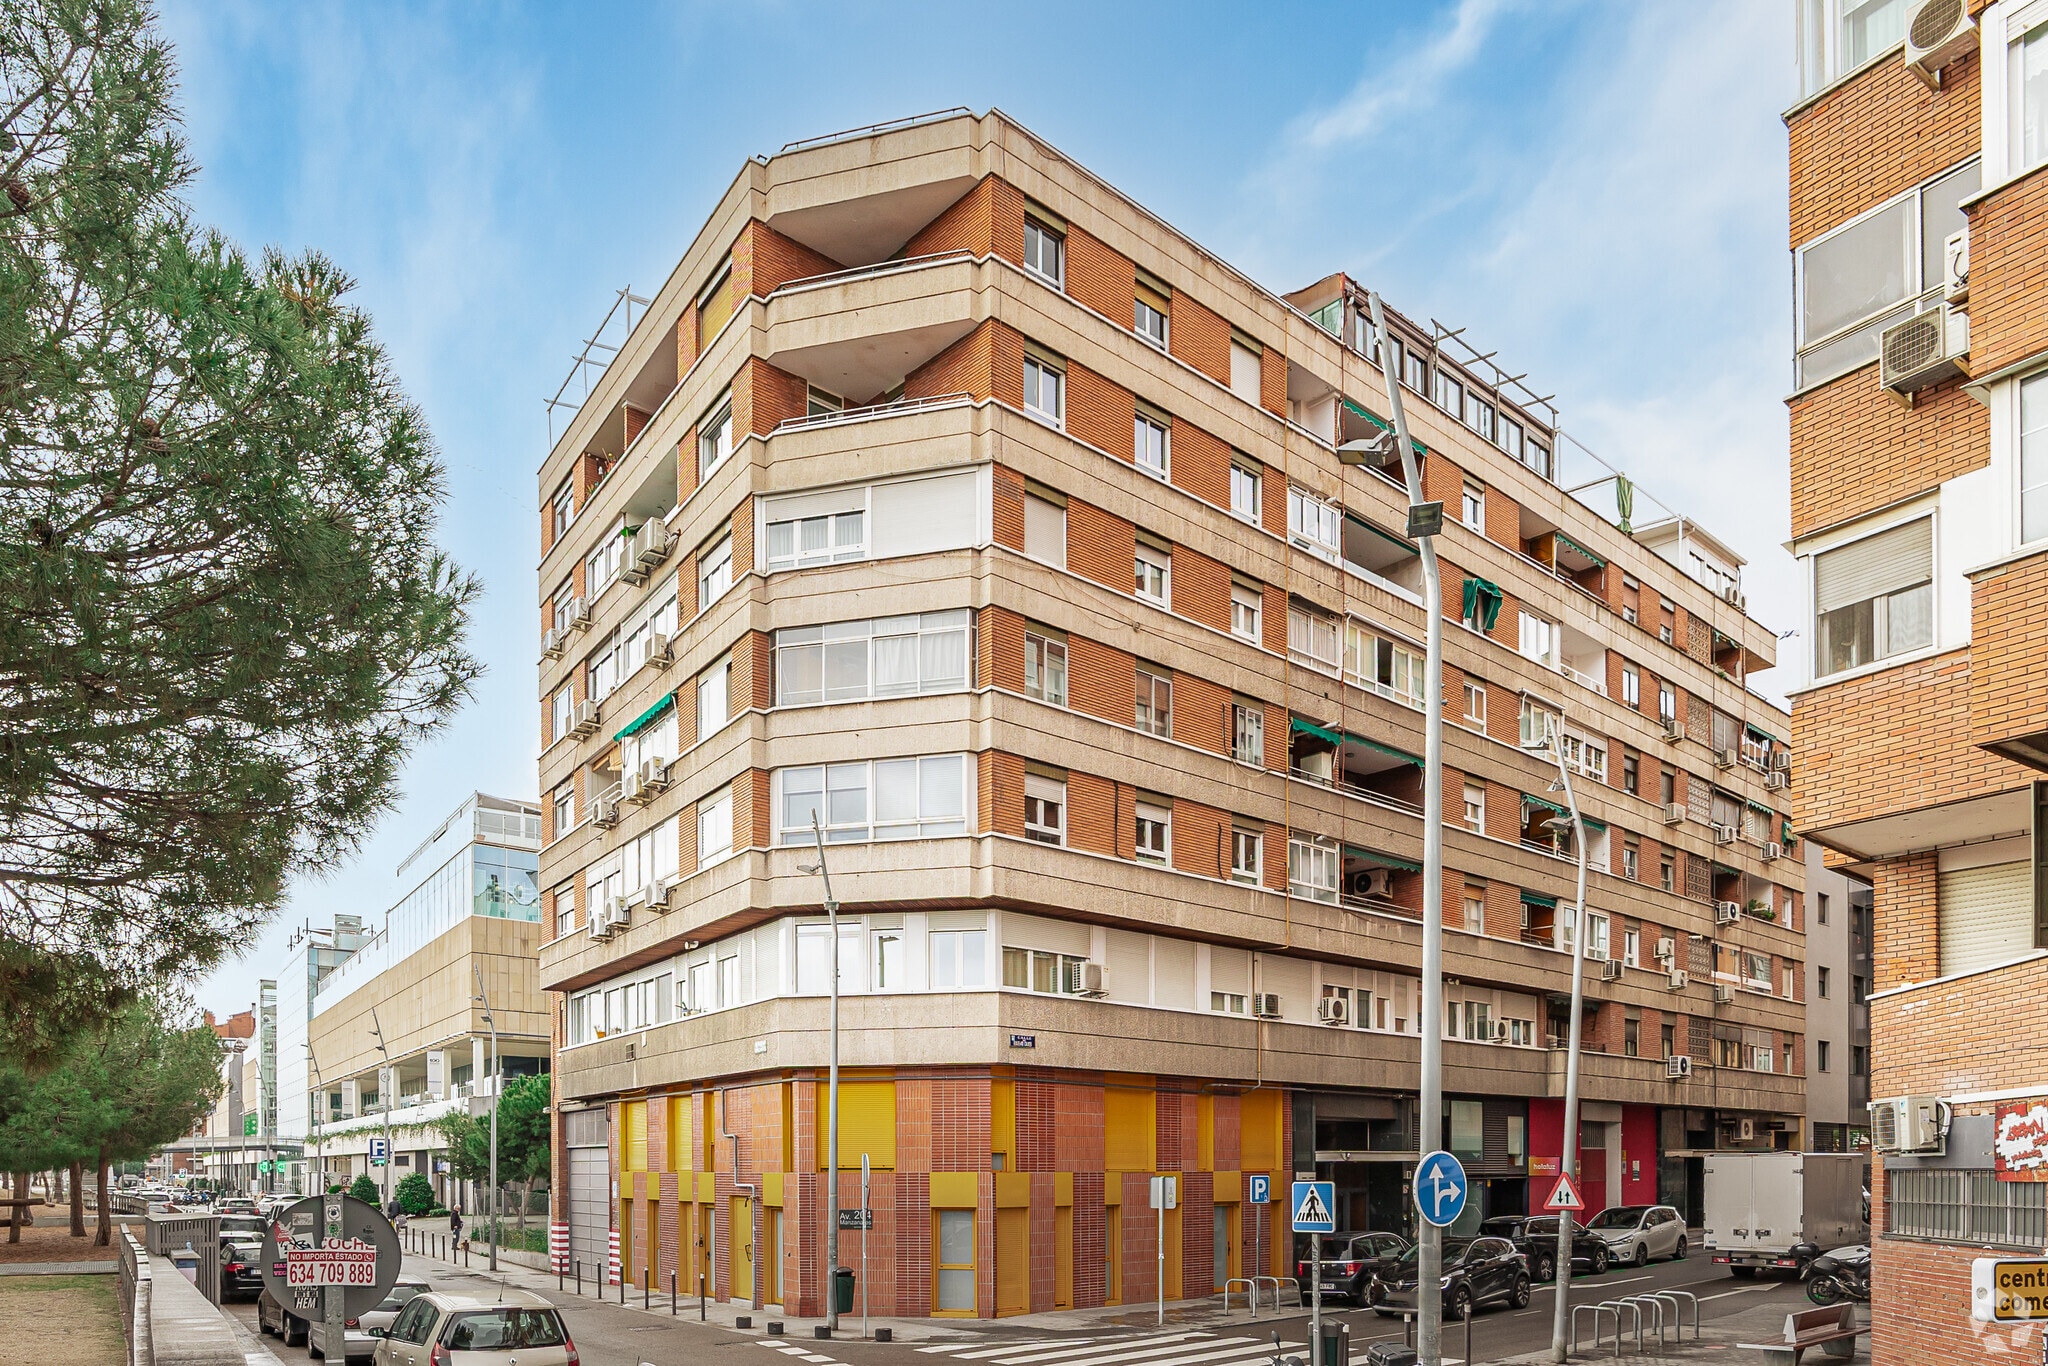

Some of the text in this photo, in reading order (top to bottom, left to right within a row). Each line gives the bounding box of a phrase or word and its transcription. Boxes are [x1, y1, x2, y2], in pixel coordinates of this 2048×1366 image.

[1255, 1179, 1266, 1200] P
[290, 1253, 301, 1261] NO
[302, 1253, 334, 1261] IMPORTA
[289, 1262, 373, 1284] 634 709 889
[2000, 1268, 2048, 1288] cent
[296, 1298, 316, 1308] HEM
